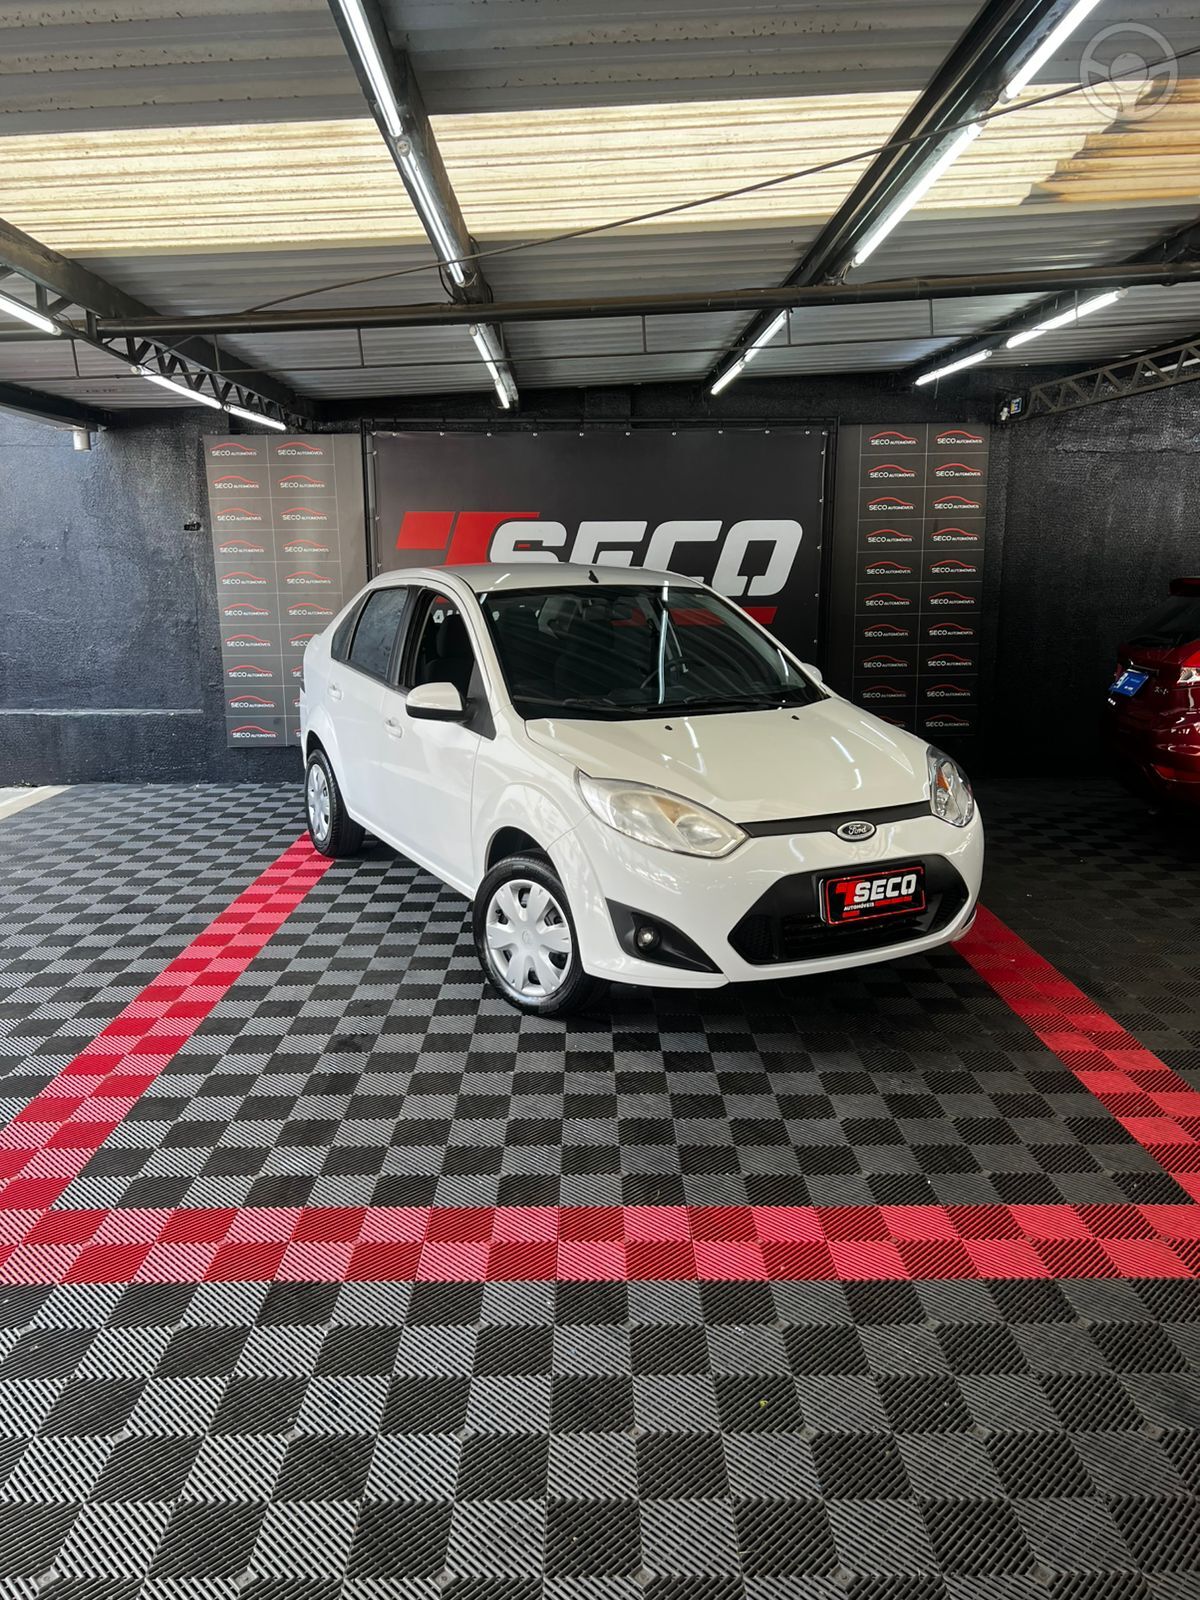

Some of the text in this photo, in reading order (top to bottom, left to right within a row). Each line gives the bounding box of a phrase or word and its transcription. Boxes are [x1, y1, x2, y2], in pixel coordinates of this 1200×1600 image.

[489, 520, 802, 597] SECO
[848, 824, 867, 834] Ford
[854, 874, 917, 902] SECO
